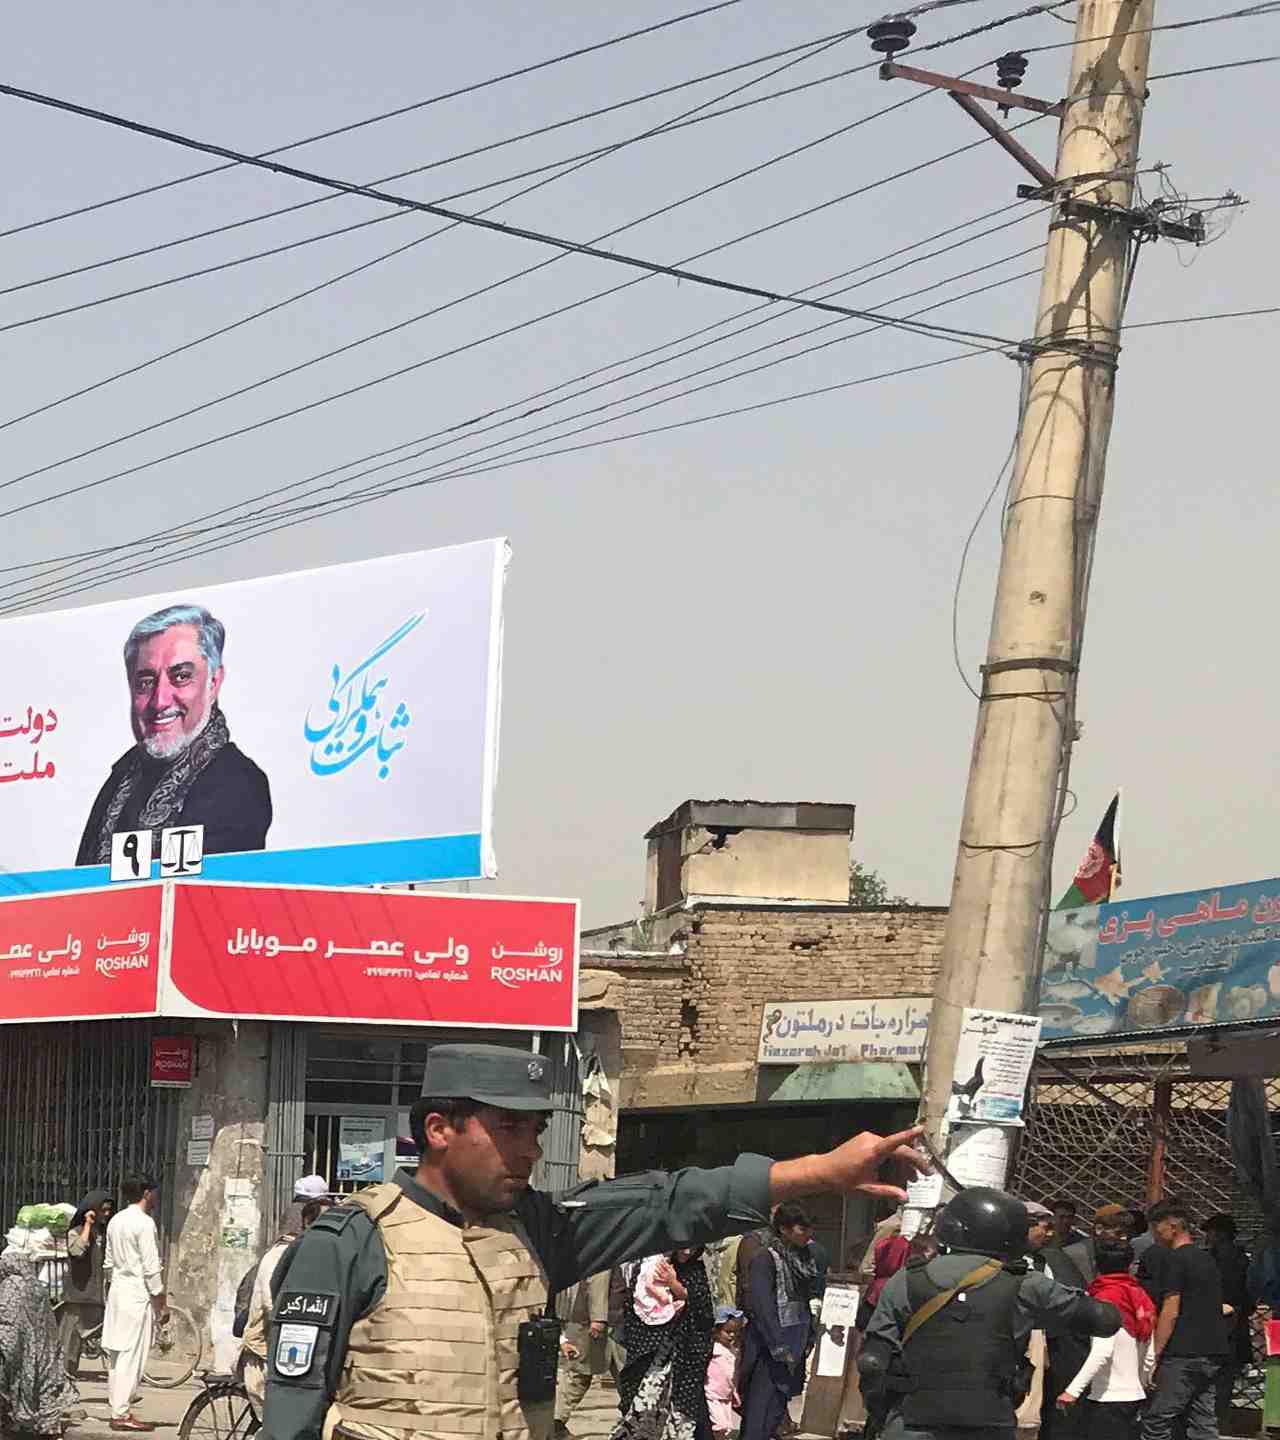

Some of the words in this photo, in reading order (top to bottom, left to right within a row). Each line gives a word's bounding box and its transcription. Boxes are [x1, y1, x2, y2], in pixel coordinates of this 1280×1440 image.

[1157, 892, 1248, 938] ماهی
[38, 934, 82, 964] ولی
[97, 928, 151, 955] روشن
[227, 928, 317, 957] موبایل
[324, 939, 404, 959] عصر
[414, 937, 470, 966] ولی
[491, 940, 564, 968] روشن
[95, 954, 149, 978] ROSHAN
[490, 966, 563, 988] ROSHAN
[279, 1295, 308, 1315] اکبر
[306, 1295, 328, 1316] الله
